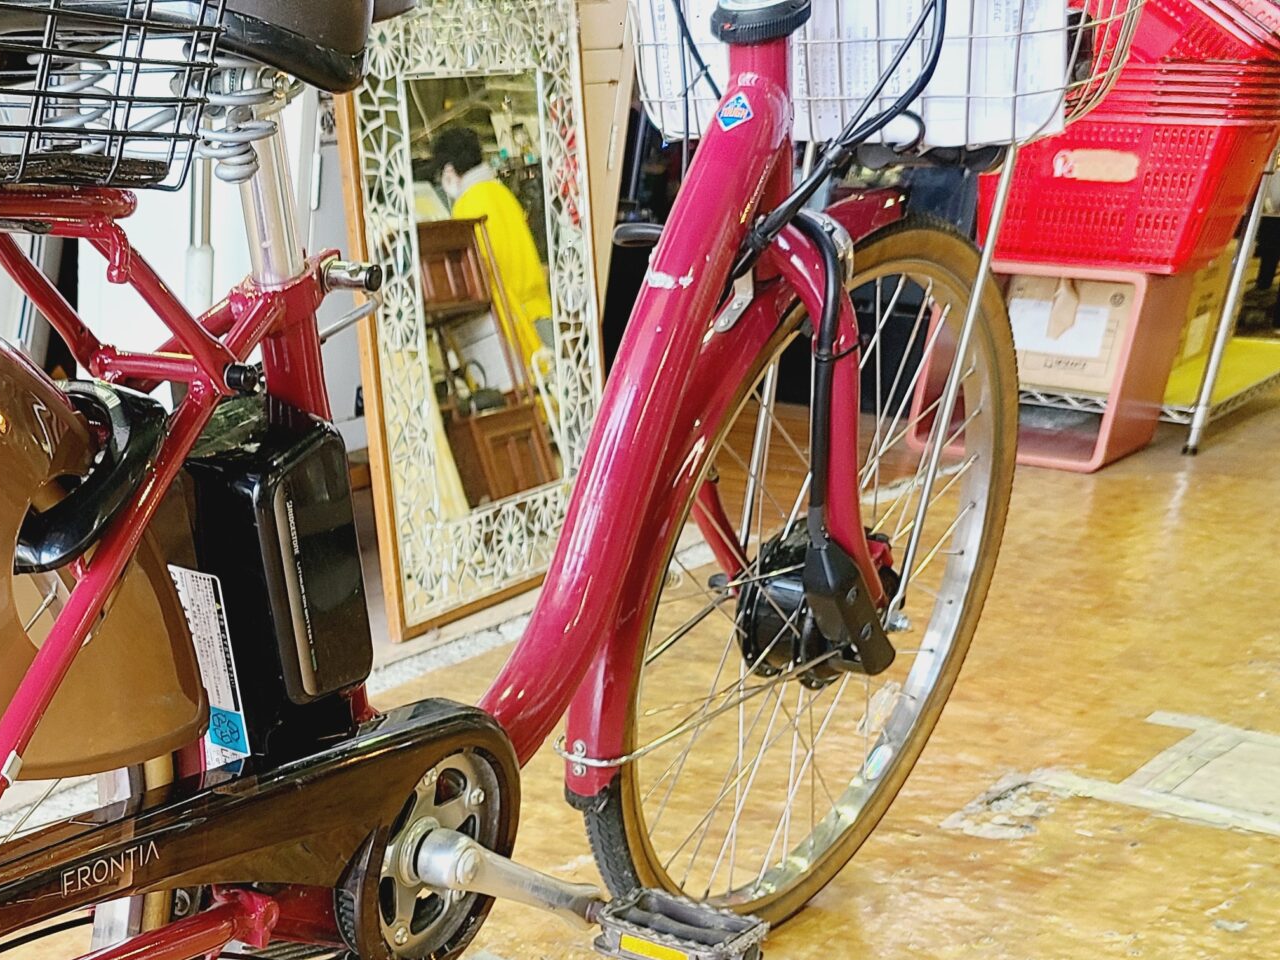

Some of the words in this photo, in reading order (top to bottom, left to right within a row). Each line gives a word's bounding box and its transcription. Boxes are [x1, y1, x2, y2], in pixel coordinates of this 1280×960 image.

[286, 500, 300, 555] BRIDGESTONE
[304, 608, 313, 645] BATTERY
[63, 841, 160, 895] FRONTIA
